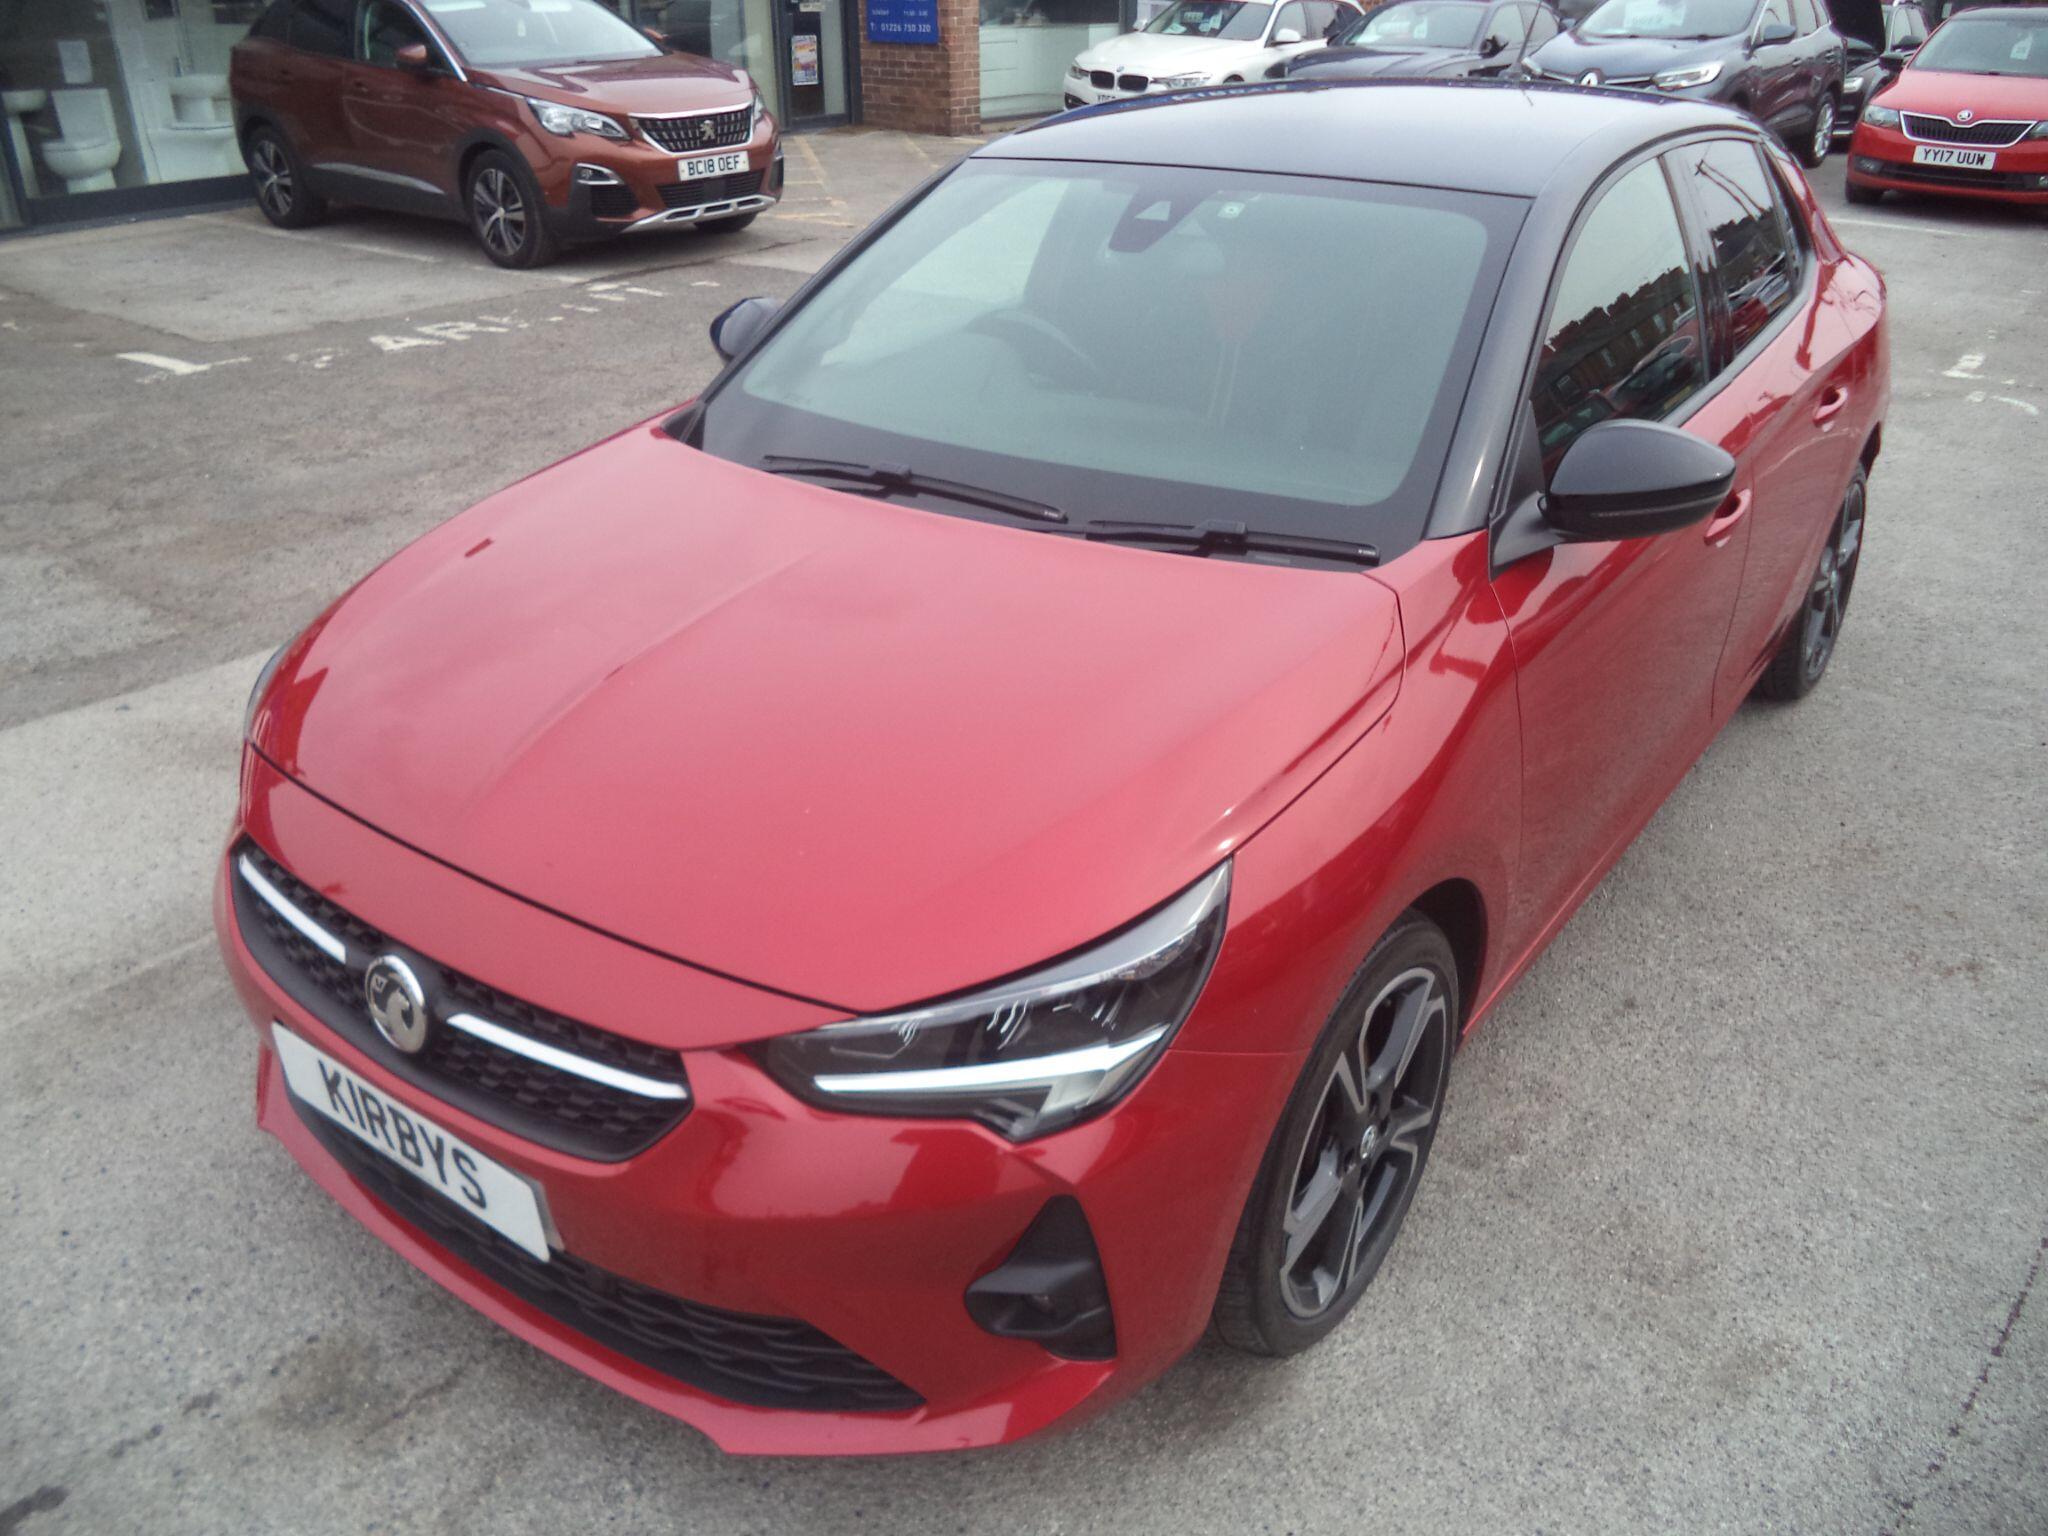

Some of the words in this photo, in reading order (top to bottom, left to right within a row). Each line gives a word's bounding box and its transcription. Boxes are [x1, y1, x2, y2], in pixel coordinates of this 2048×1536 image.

[687, 159, 715, 176] BC18
[718, 155, 739, 171] OEF
[1923, 148, 1954, 163] YY17
[1957, 151, 1986, 166] UUW
[317, 1059, 487, 1210] KIRBYS
